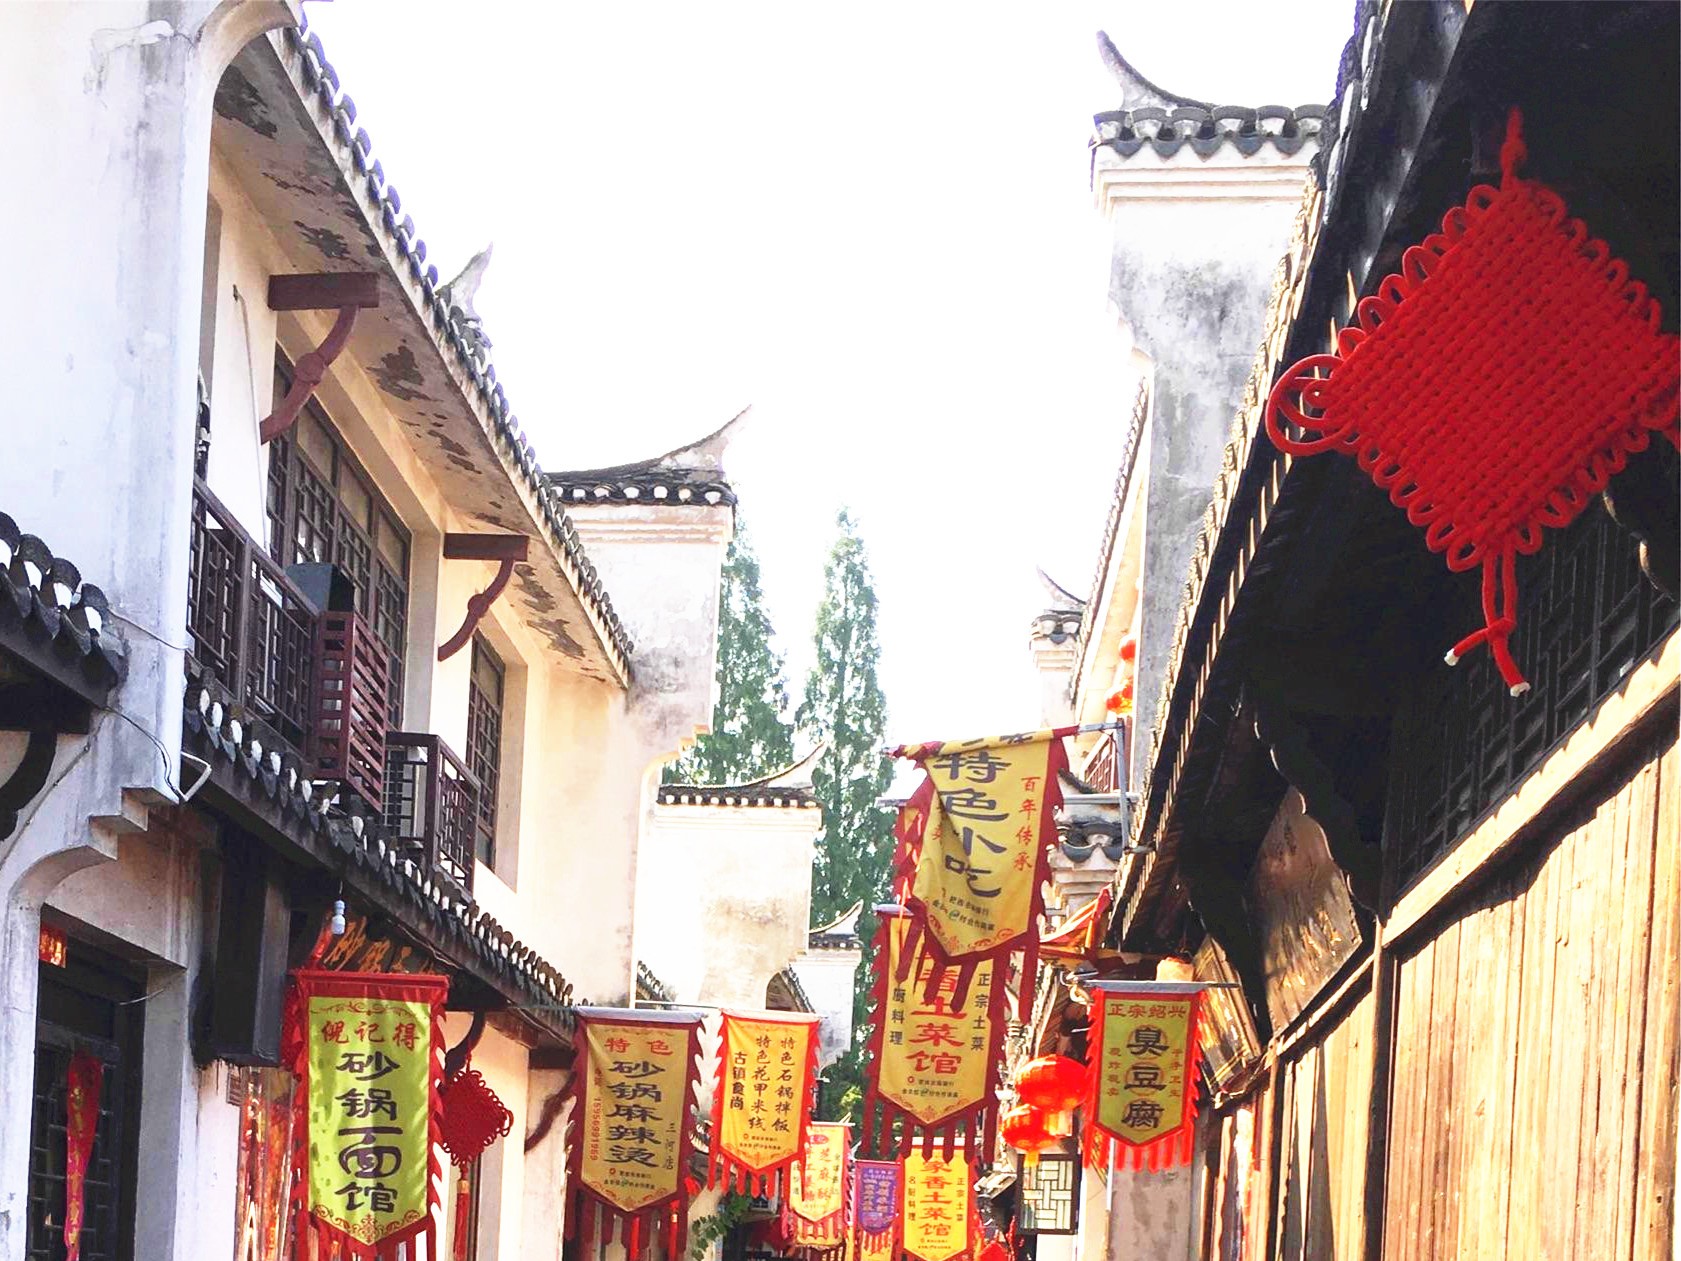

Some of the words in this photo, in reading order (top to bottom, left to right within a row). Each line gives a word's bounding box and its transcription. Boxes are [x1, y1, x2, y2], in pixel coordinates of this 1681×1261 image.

[933, 751, 1011, 898] 特色小吃
[1014, 776, 1041, 871] 百年传承
[604, 1038, 674, 1056] 特色
[970, 973, 991, 1051] 正宗土菜
[1107, 1003, 1187, 1018] 正宗绍兴
[603, 1060, 666, 1168] 砂锅麻辣烫
[748, 1034, 772, 1131] 特色花甲米线
[772, 1036, 797, 1132] 特色石锅拌饭
[1121, 1026, 1170, 1129] 臭豆腐
[335, 1052, 403, 1213] 砂锅面馆
[662, 1122, 676, 1170] 三河店
